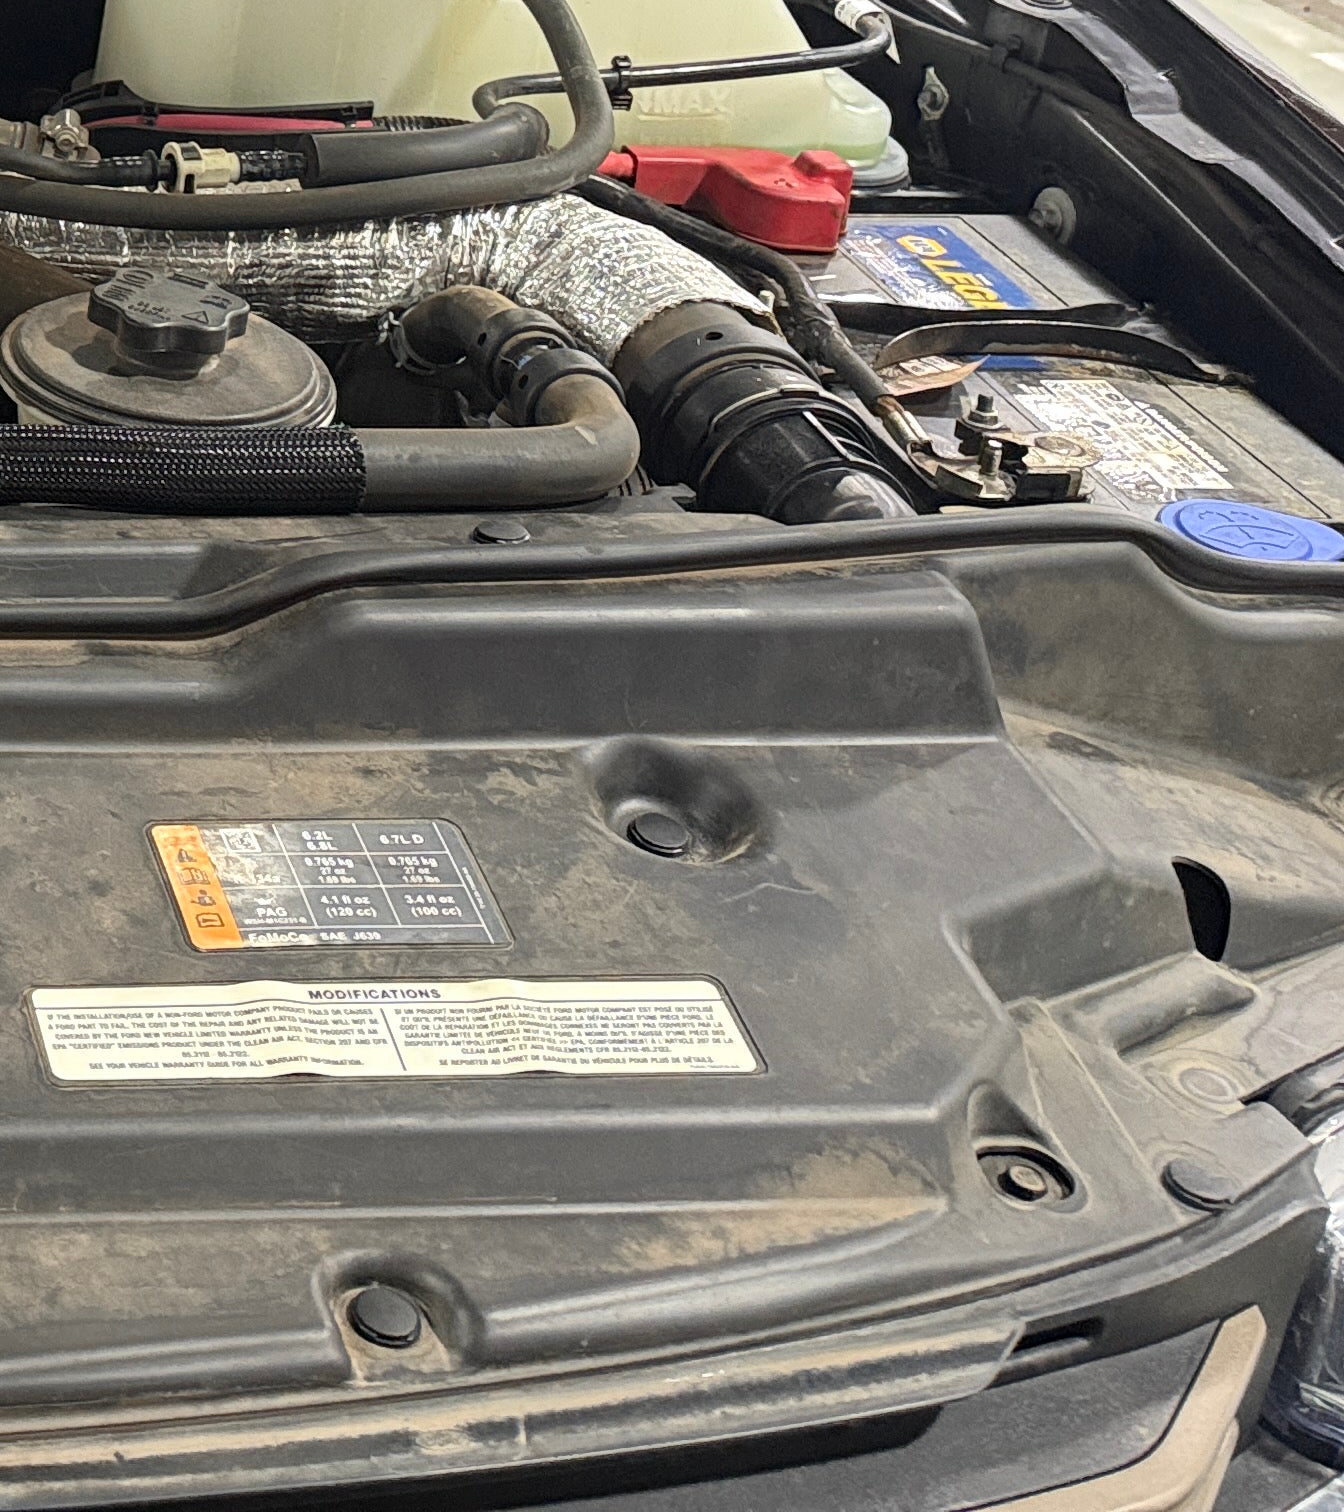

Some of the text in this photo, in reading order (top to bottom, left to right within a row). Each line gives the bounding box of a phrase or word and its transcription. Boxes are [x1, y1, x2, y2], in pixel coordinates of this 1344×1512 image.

[379, 834, 425, 845] 6.7L D
[337, 857, 355, 868] kg
[420, 856, 439, 868] kg
[320, 894, 371, 905] 4.1 fl oz
[404, 894, 425, 905] 3.4
[439, 895, 455, 904] oz
[256, 907, 288, 917] PAG
[325, 907, 378, 918] (120 cc)
[411, 906, 463, 918] (100 cc)
[320, 932, 348, 941] SAE
[307, 988, 442, 1000] MODIFICATIONS
